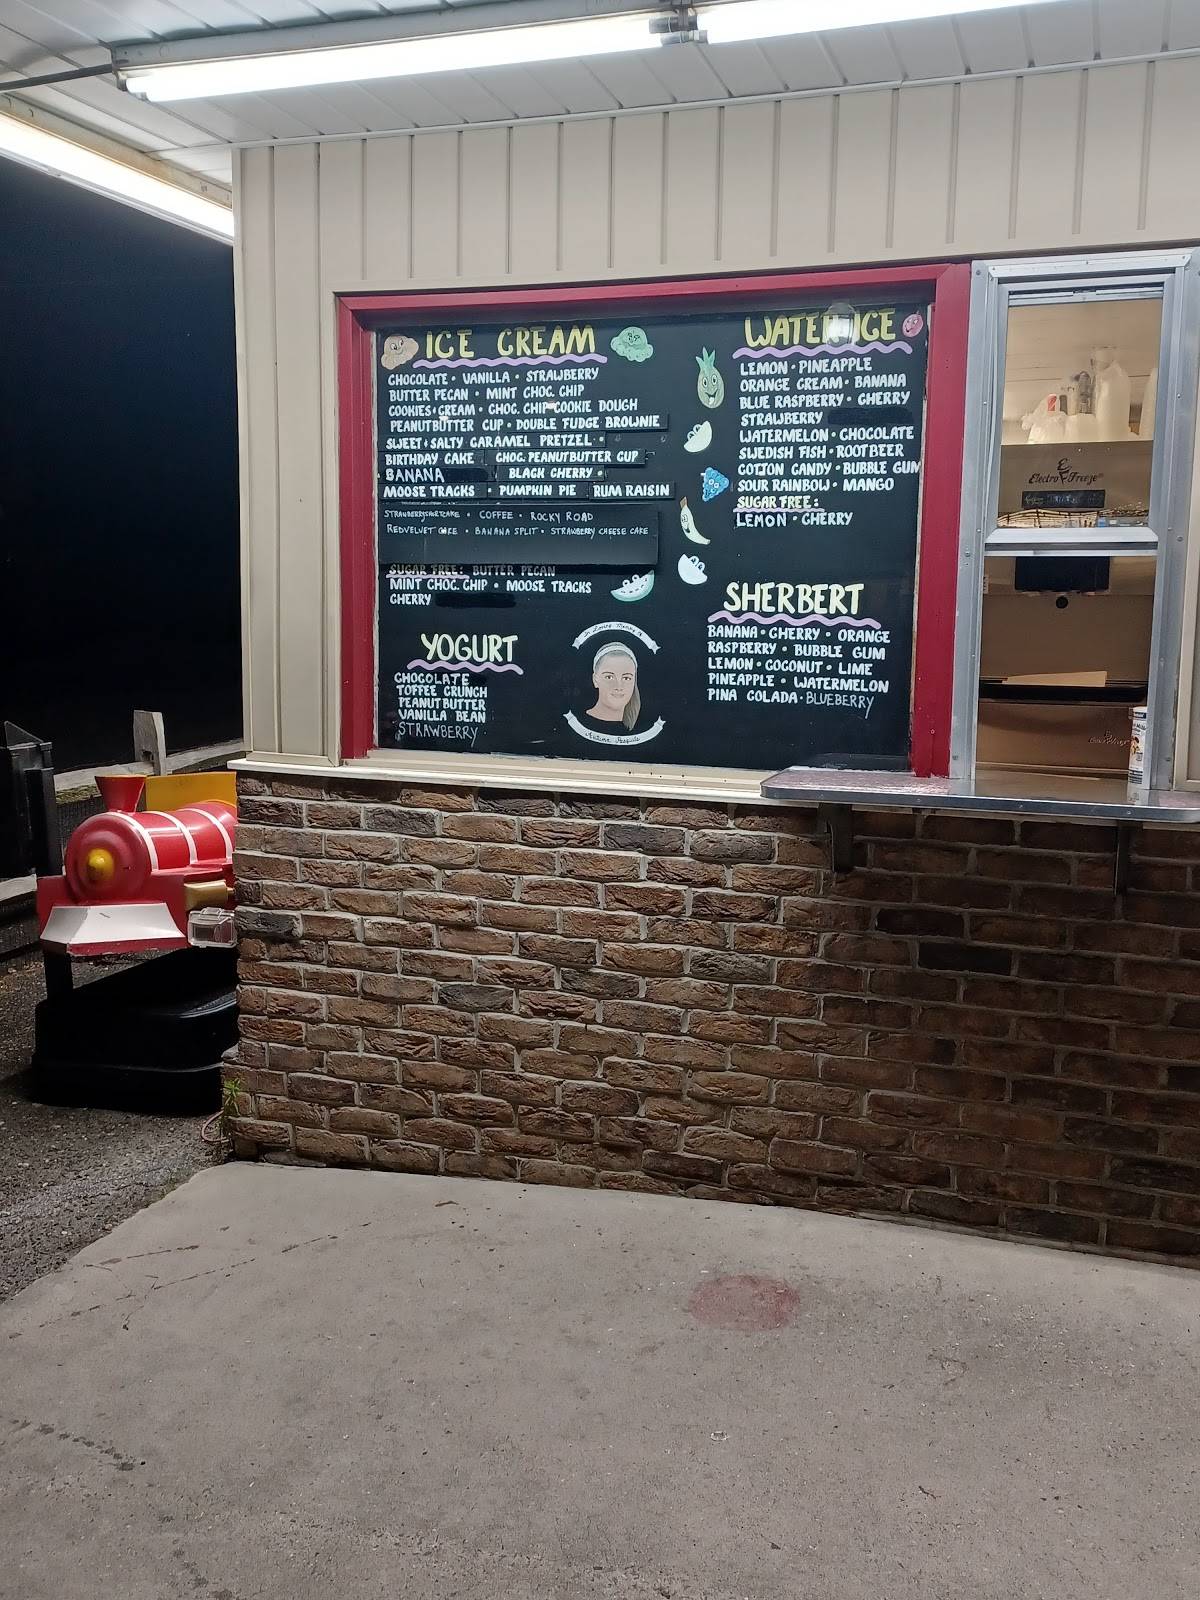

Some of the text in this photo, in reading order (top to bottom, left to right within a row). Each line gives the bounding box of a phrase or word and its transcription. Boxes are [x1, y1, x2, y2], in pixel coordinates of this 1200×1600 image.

[851, 308, 896, 345] ICE
[426, 324, 596, 359] ICE CREAM
[740, 357, 872, 376] LEMON PINEAPPLE
[388, 367, 599, 386] CHOCOLATE VANILLA STRAWBERRY
[740, 374, 906, 392] ORANGE CREAM BANANA
[389, 384, 584, 402] BUTTER PECAN MINT CHOC. CHIP
[739, 391, 911, 410] BLUE RASPBERRY CHERRY
[388, 405, 431, 417] COOKIES
[438, 404, 476, 416] CREAM
[488, 403, 519, 415] CHOC.
[523, 402, 548, 414] CHIP
[554, 400, 592, 414] COOKIE
[598, 398, 638, 412] DOUGH
[482, 419, 503, 431] CUP
[516, 418, 556, 430] DOUBLE
[562, 417, 599, 429] FUDGE
[605, 415, 660, 428] BROWNIE
[741, 412, 823, 427] STRAWBERRY
[386, 438, 422, 449] SWEET
[430, 436, 464, 449] SALTY
[470, 435, 530, 448] CARAMEL
[540, 434, 592, 446] PRETZEL
[739, 426, 915, 443] WATERMELON CHOCOLATE
[385, 453, 438, 465] BIRTHDAY
[444, 453, 474, 464] CAKE
[495, 452, 526, 463] CHOC.
[617, 451, 638, 462] CUP
[738, 446, 793, 460] SWEDISH
[798, 445, 826, 458] FISH
[385, 467, 593, 483] BANANA BLACK CHERRY
[737, 463, 784, 476] COTTON
[791, 462, 832, 475] CANDY
[843, 461, 887, 475] BUBBLE
[737, 478, 894, 492] SOUR RAINBOW MANGO
[1029, 473, 1058, 483] Electro
[384, 484, 670, 498] MOOSE TRACKS PUMPKIN PIE RUM RAISIN
[737, 496, 776, 509] SUGAR
[479, 511, 513, 519] COFFEE
[531, 512, 560, 523] ROCKY
[566, 512, 593, 522] ROAD
[736, 512, 853, 528] LEMON CHERRY
[475, 527, 510, 536] BANANA
[514, 526, 538, 535] SPLIT
[599, 527, 626, 535] CHEESE
[630, 527, 648, 535] CAKE
[388, 564, 427, 575] SUGAR
[473, 566, 514, 576] BUTTER
[521, 566, 555, 576] PECAN
[389, 578, 592, 593] MINT CHOC. CHIP MOOSE TRACKS
[390, 593, 432, 605] CHERRY
[723, 581, 864, 615] SHERBERT
[707, 625, 891, 643] BANANA CHERRY ORANGE
[421, 633, 518, 662] YOGURT
[707, 641, 886, 660] RASPBERRY BUBBLE GUM
[708, 657, 873, 676] LEMON COCONUT LIME
[394, 673, 470, 686] CHOCOLATE
[707, 673, 889, 693] PINEAPPLE WATERMELON
[396, 685, 488, 698] TOFFEE CRUNCH
[707, 688, 874, 719] PINA COLADA BLUEBERRY
[398, 709, 486, 723] VANILLA BEAN
[398, 722, 478, 747] STRAWBERRY
